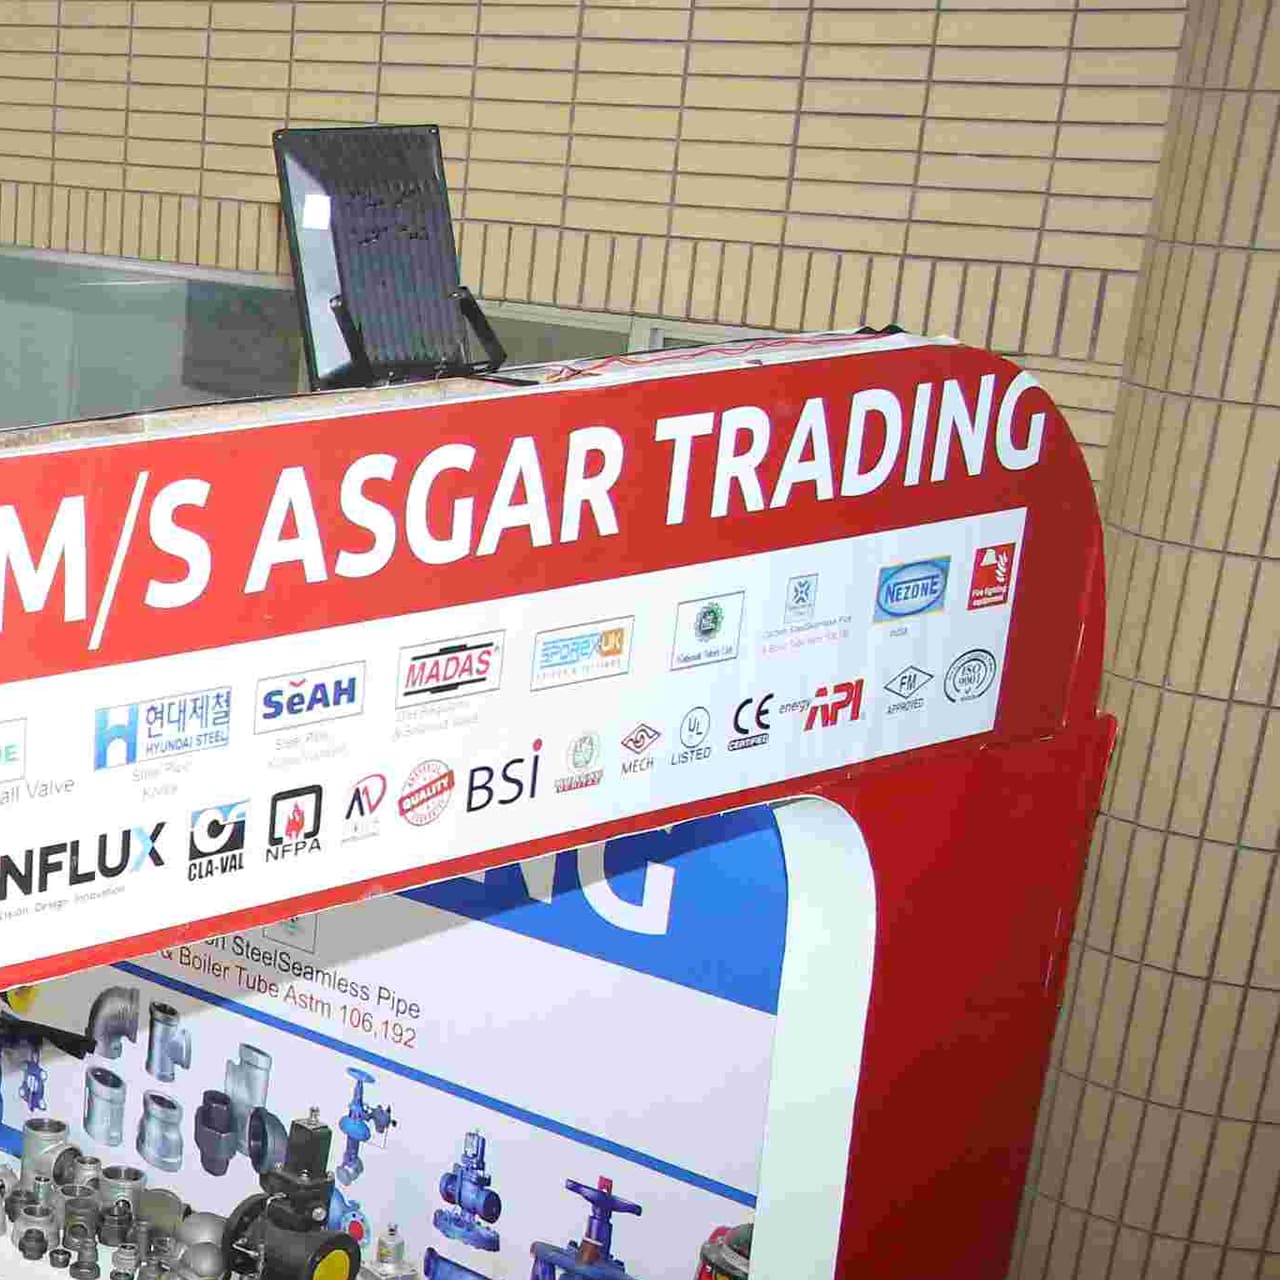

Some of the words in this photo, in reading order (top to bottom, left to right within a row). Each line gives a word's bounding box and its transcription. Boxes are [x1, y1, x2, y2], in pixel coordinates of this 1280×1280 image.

[243, 426, 625, 594] ASGAR
[655, 370, 1046, 526] TRADING
[885, 575, 940, 604] NEZONE
[404, 649, 492, 689] MADAS
[898, 674, 917, 692] FM
[145, 690, 231, 738] 현대제철
[733, 693, 774, 735] CE
[779, 698, 811, 715] energy
[803, 678, 865, 732] API
[195, 728, 228, 747] STEEL
[621, 756, 654, 776] MECH
[671, 747, 712, 766] LISTED
[27, 775, 75, 799] Valve
[265, 839, 322, 864] NFPA
[188, 852, 244, 882] CLA-VAL
[179, 945, 230, 980] Boiler
[236, 965, 279, 998] Tube
[284, 983, 332, 1019] Astm
[340, 1005, 417, 1048] 106,192
[376, 985, 421, 1019] Pipe
